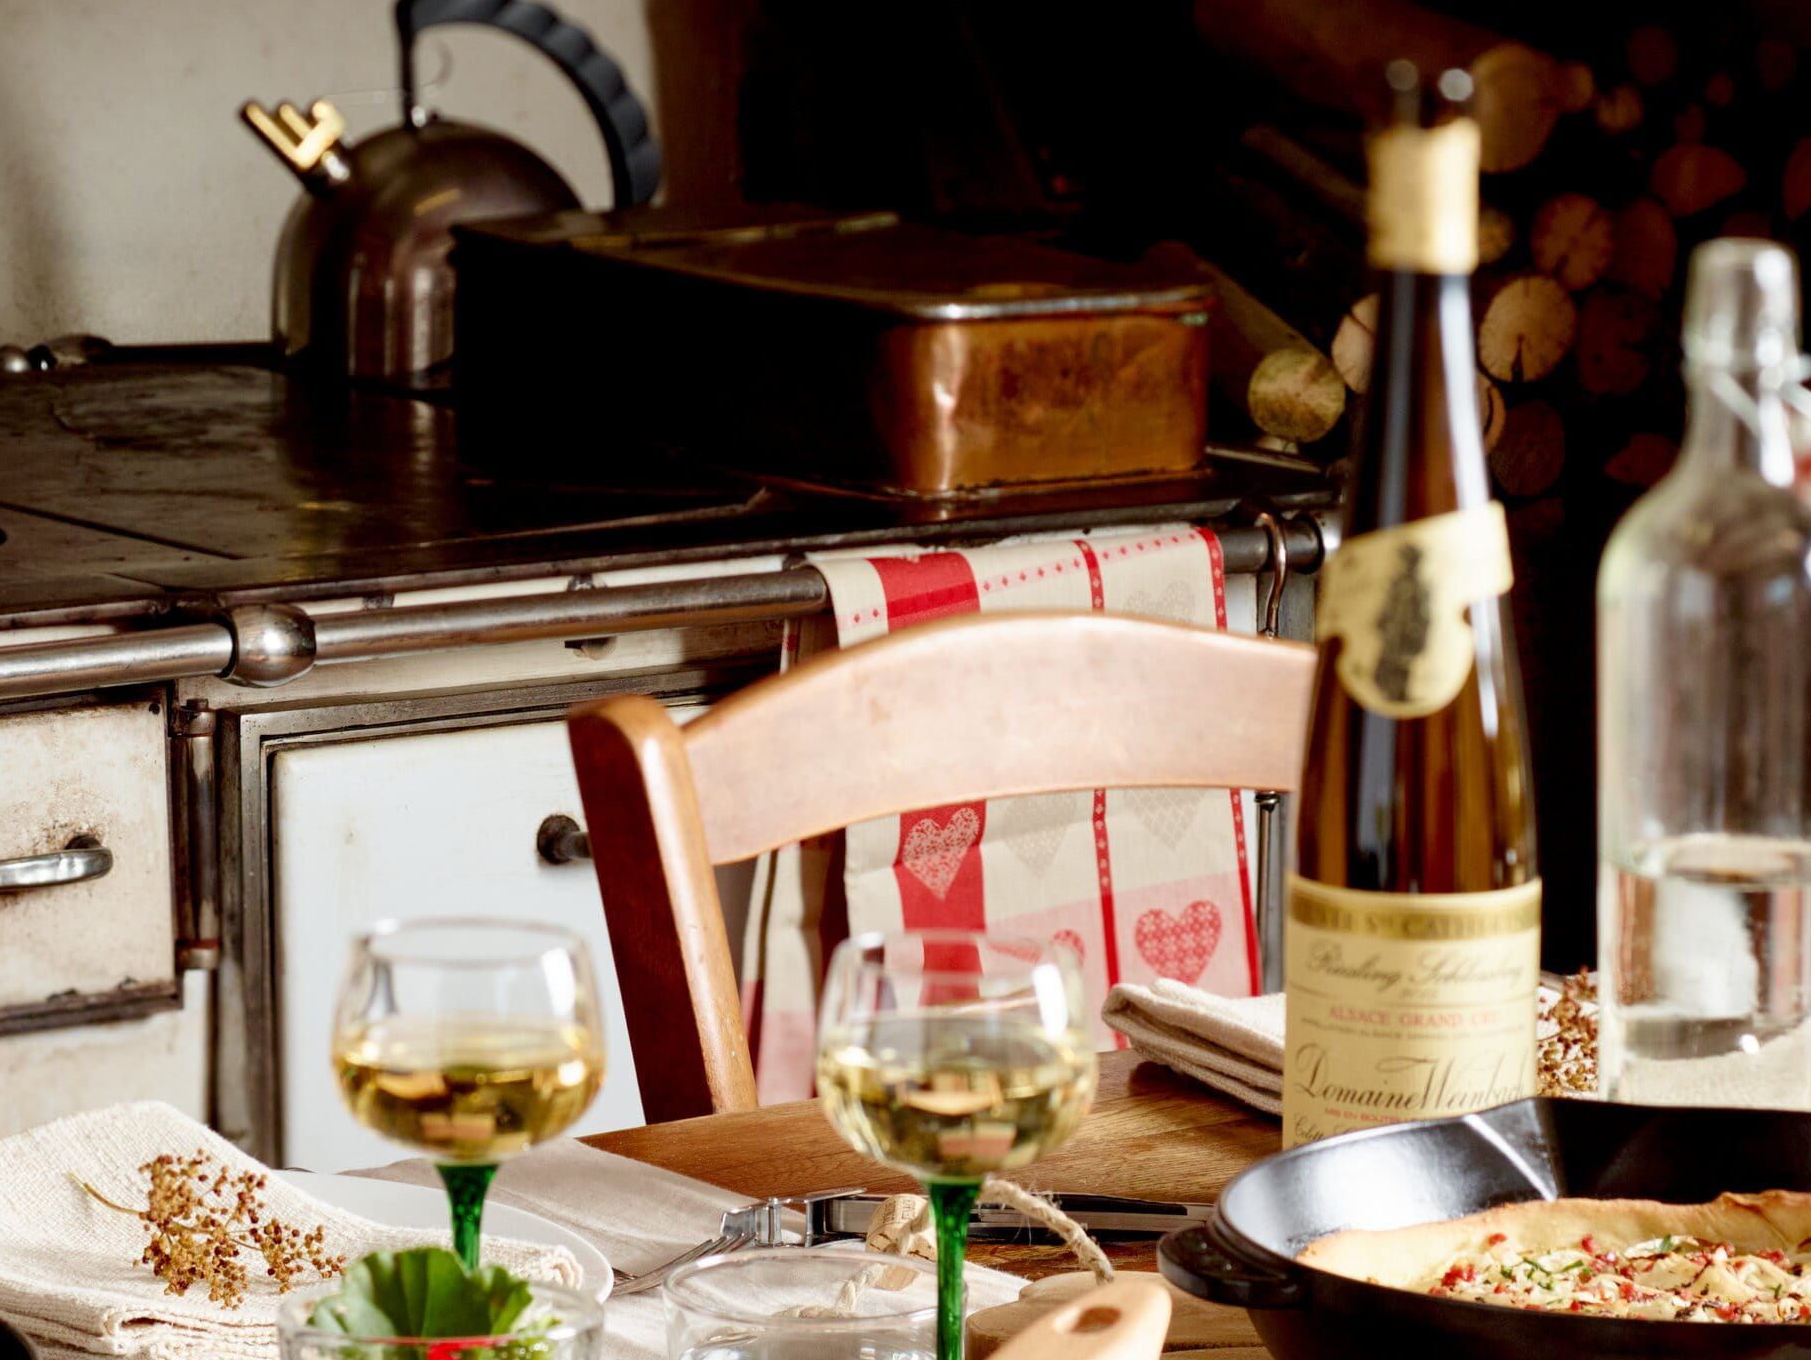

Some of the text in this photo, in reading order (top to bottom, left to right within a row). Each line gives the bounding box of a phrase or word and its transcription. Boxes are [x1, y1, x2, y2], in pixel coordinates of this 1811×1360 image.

[1330, 1006, 1389, 1027] ALSACE
[1399, 1009, 1464, 1027] GRAND
[1293, 1043, 1419, 1110] Domaine
